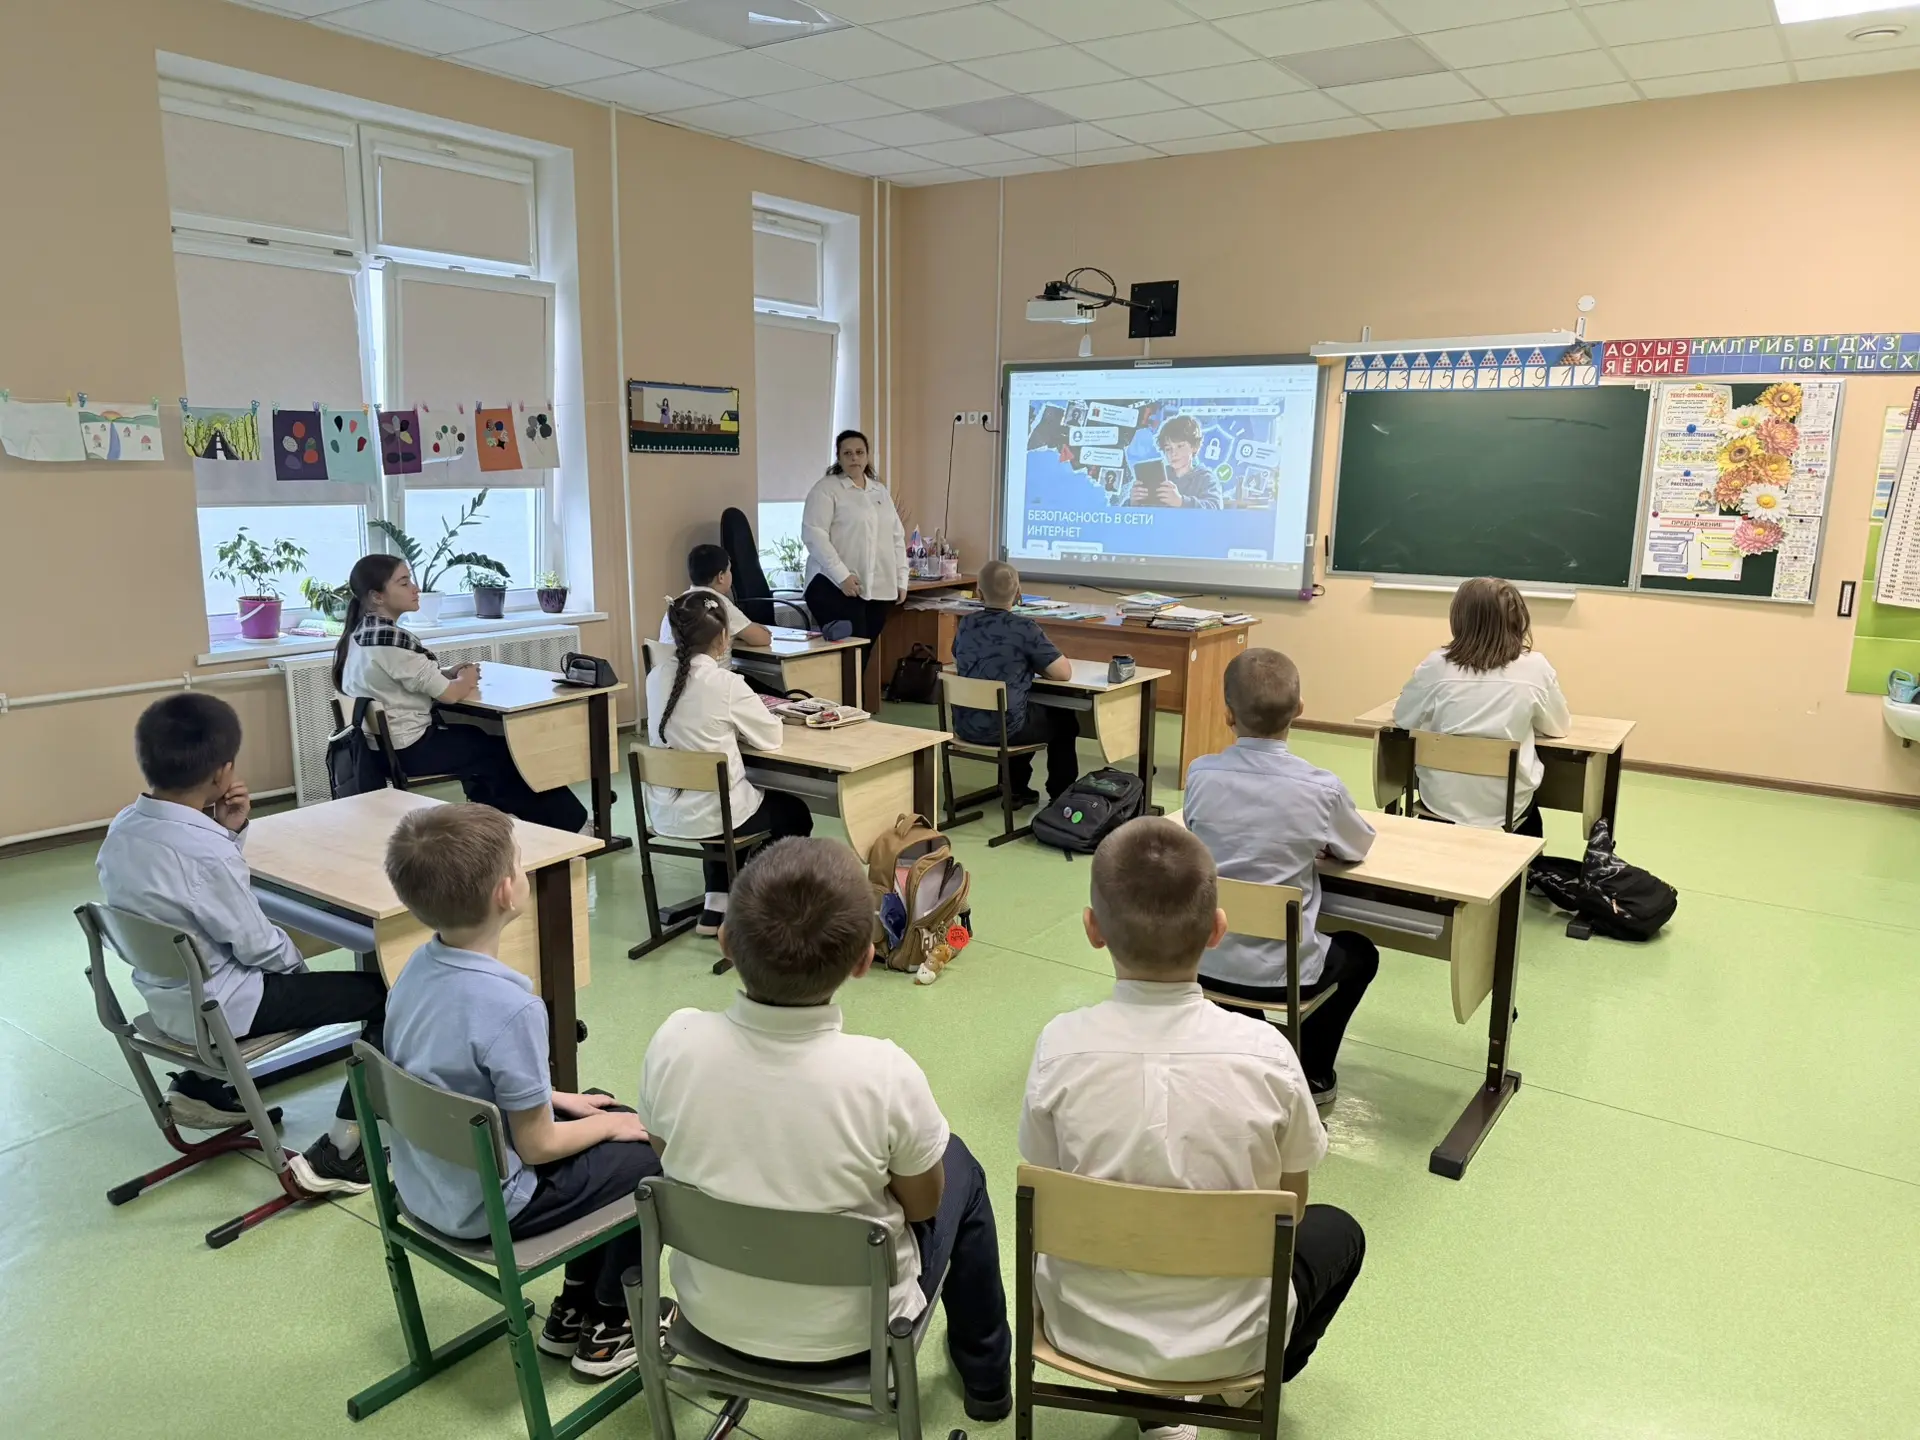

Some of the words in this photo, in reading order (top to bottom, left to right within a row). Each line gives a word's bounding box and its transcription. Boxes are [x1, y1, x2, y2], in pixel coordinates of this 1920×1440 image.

[1355, 371, 1366, 390] 1
[1374, 370, 1387, 390] 2
[1395, 369, 1408, 390] 3
[1418, 370, 1431, 389] 4
[1439, 369, 1453, 389] 5
[1462, 369, 1475, 389] 6
[1488, 368, 1498, 388] 7
[1508, 367, 1522, 388] 8
[1532, 367, 1546, 388] 9
[1028, 509, 1112, 524] БЕЗОПАСНОСТЬ
[1114, 514, 1121, 524] В
[1124, 513, 1154, 525] СЕТИ
[1671, 520, 1722, 528] ПРЕДЛОЖЕНИЕ
[1027, 524, 1082, 538] ИНТЕРНЕТ
